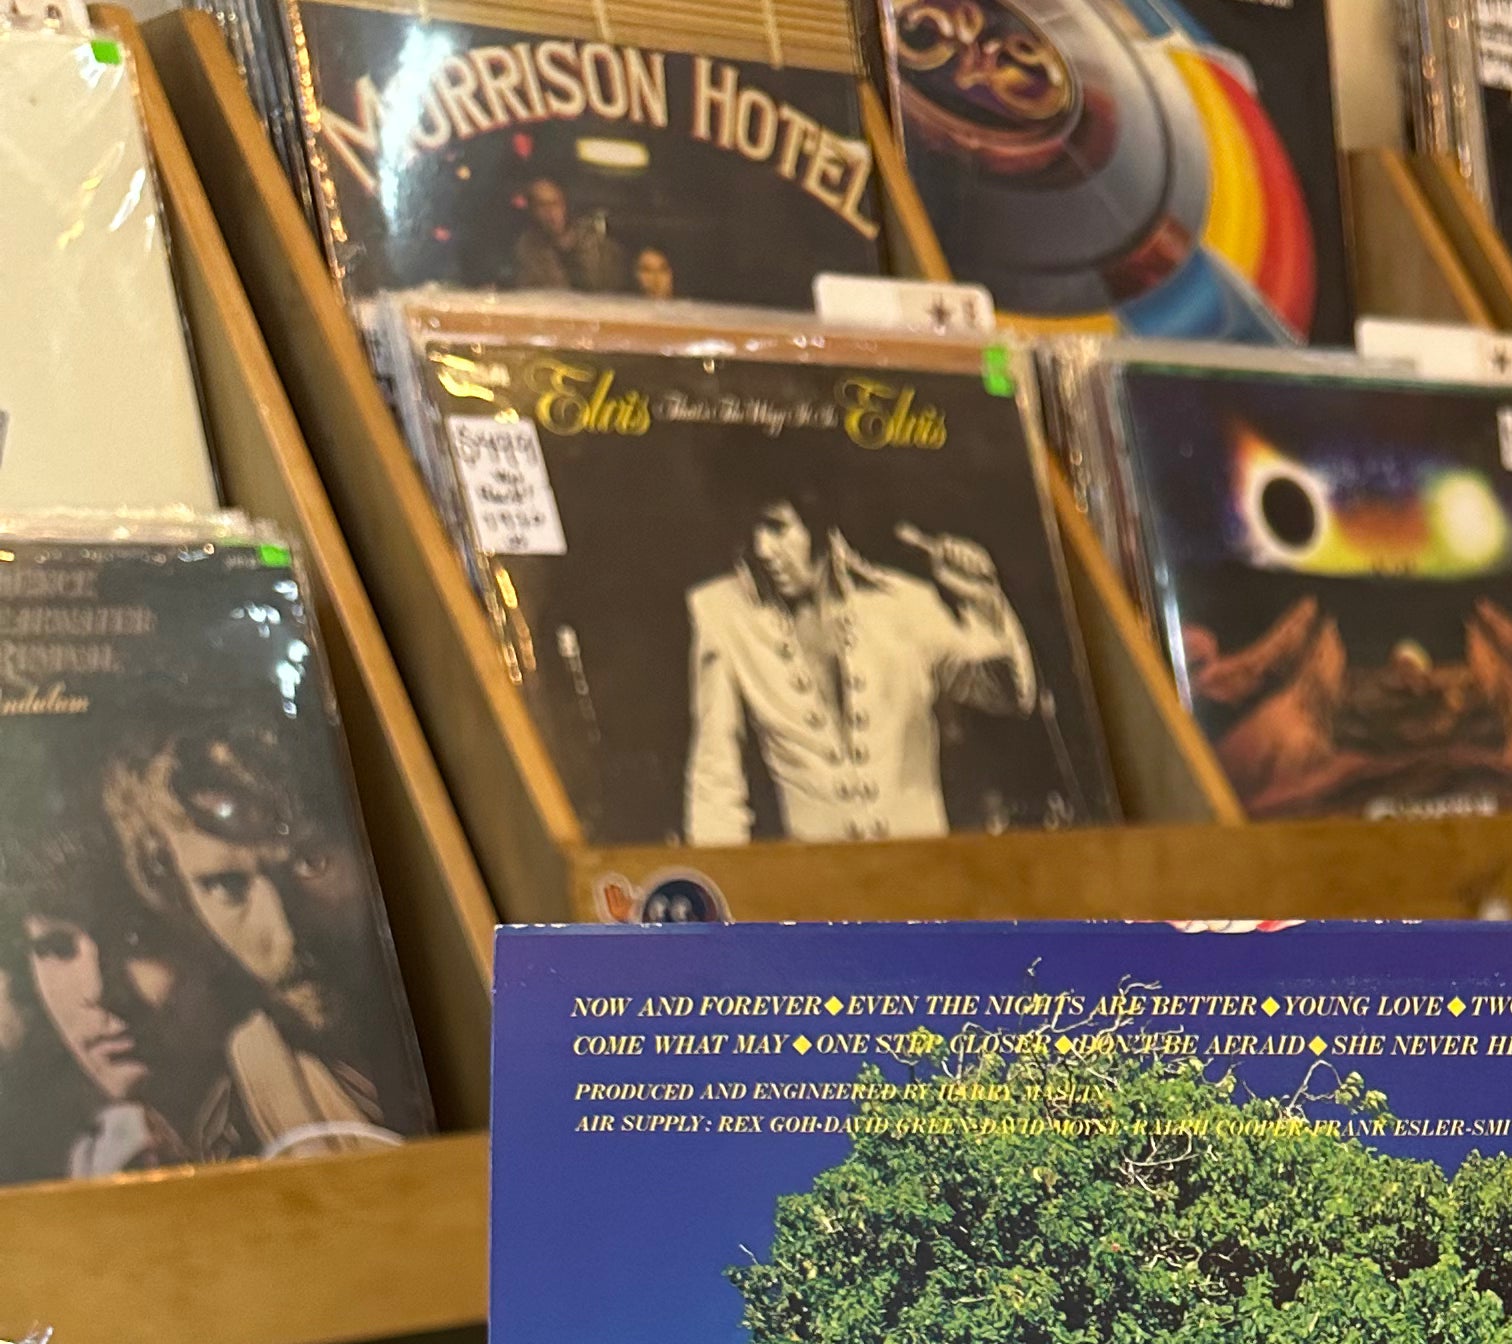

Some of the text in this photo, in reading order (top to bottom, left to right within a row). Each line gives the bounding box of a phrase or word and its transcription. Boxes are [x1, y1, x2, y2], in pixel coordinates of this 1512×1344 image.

[694, 58, 878, 240] HOTEL
[525, 358, 652, 437] Elvis
[835, 375, 967, 450] Elvis
[571, 996, 631, 1017] NOW
[638, 996, 694, 1017] AND
[699, 996, 822, 1017] FOREVER
[850, 996, 917, 1017] EVEN
[928, 996, 980, 1017] THE
[985, 996, 1085, 1017] NIGHTS
[1093, 996, 1146, 1017] ARE
[1152, 996, 1257, 1017] BETTER
[1284, 996, 1370, 1017] YOUNG
[1377, 996, 1444, 1017] LOVE
[573, 1035, 645, 1056] COME
[655, 1035, 728, 1056] WHAT
[732, 1035, 790, 1056] MAY
[816, 1035, 870, 1056] ONE
[876, 1035, 942, 1056] STEP
[950, 1035, 1053, 1056] CLOSER
[1075, 1035, 1160, 1056] DON'T
[1163, 1035, 1200, 1056] BE
[1205, 1035, 1306, 1056] AFRAID
[1332, 1035, 1386, 1056] SHE
[1391, 1035, 1479, 1056] NEVER
[574, 1083, 694, 1102] PRODUCED
[701, 1083, 747, 1102] AND
[753, 1083, 897, 1102] ENGINEERED
[575, 1116, 615, 1134] AIR
[620, 1116, 713, 1134] SUPPLY:
[718, 1116, 762, 1134] REX
[770, 1116, 817, 1134] GOH
[824, 1116, 888, 1134] DAVID
[1314, 1116, 1387, 1134] FRANK
